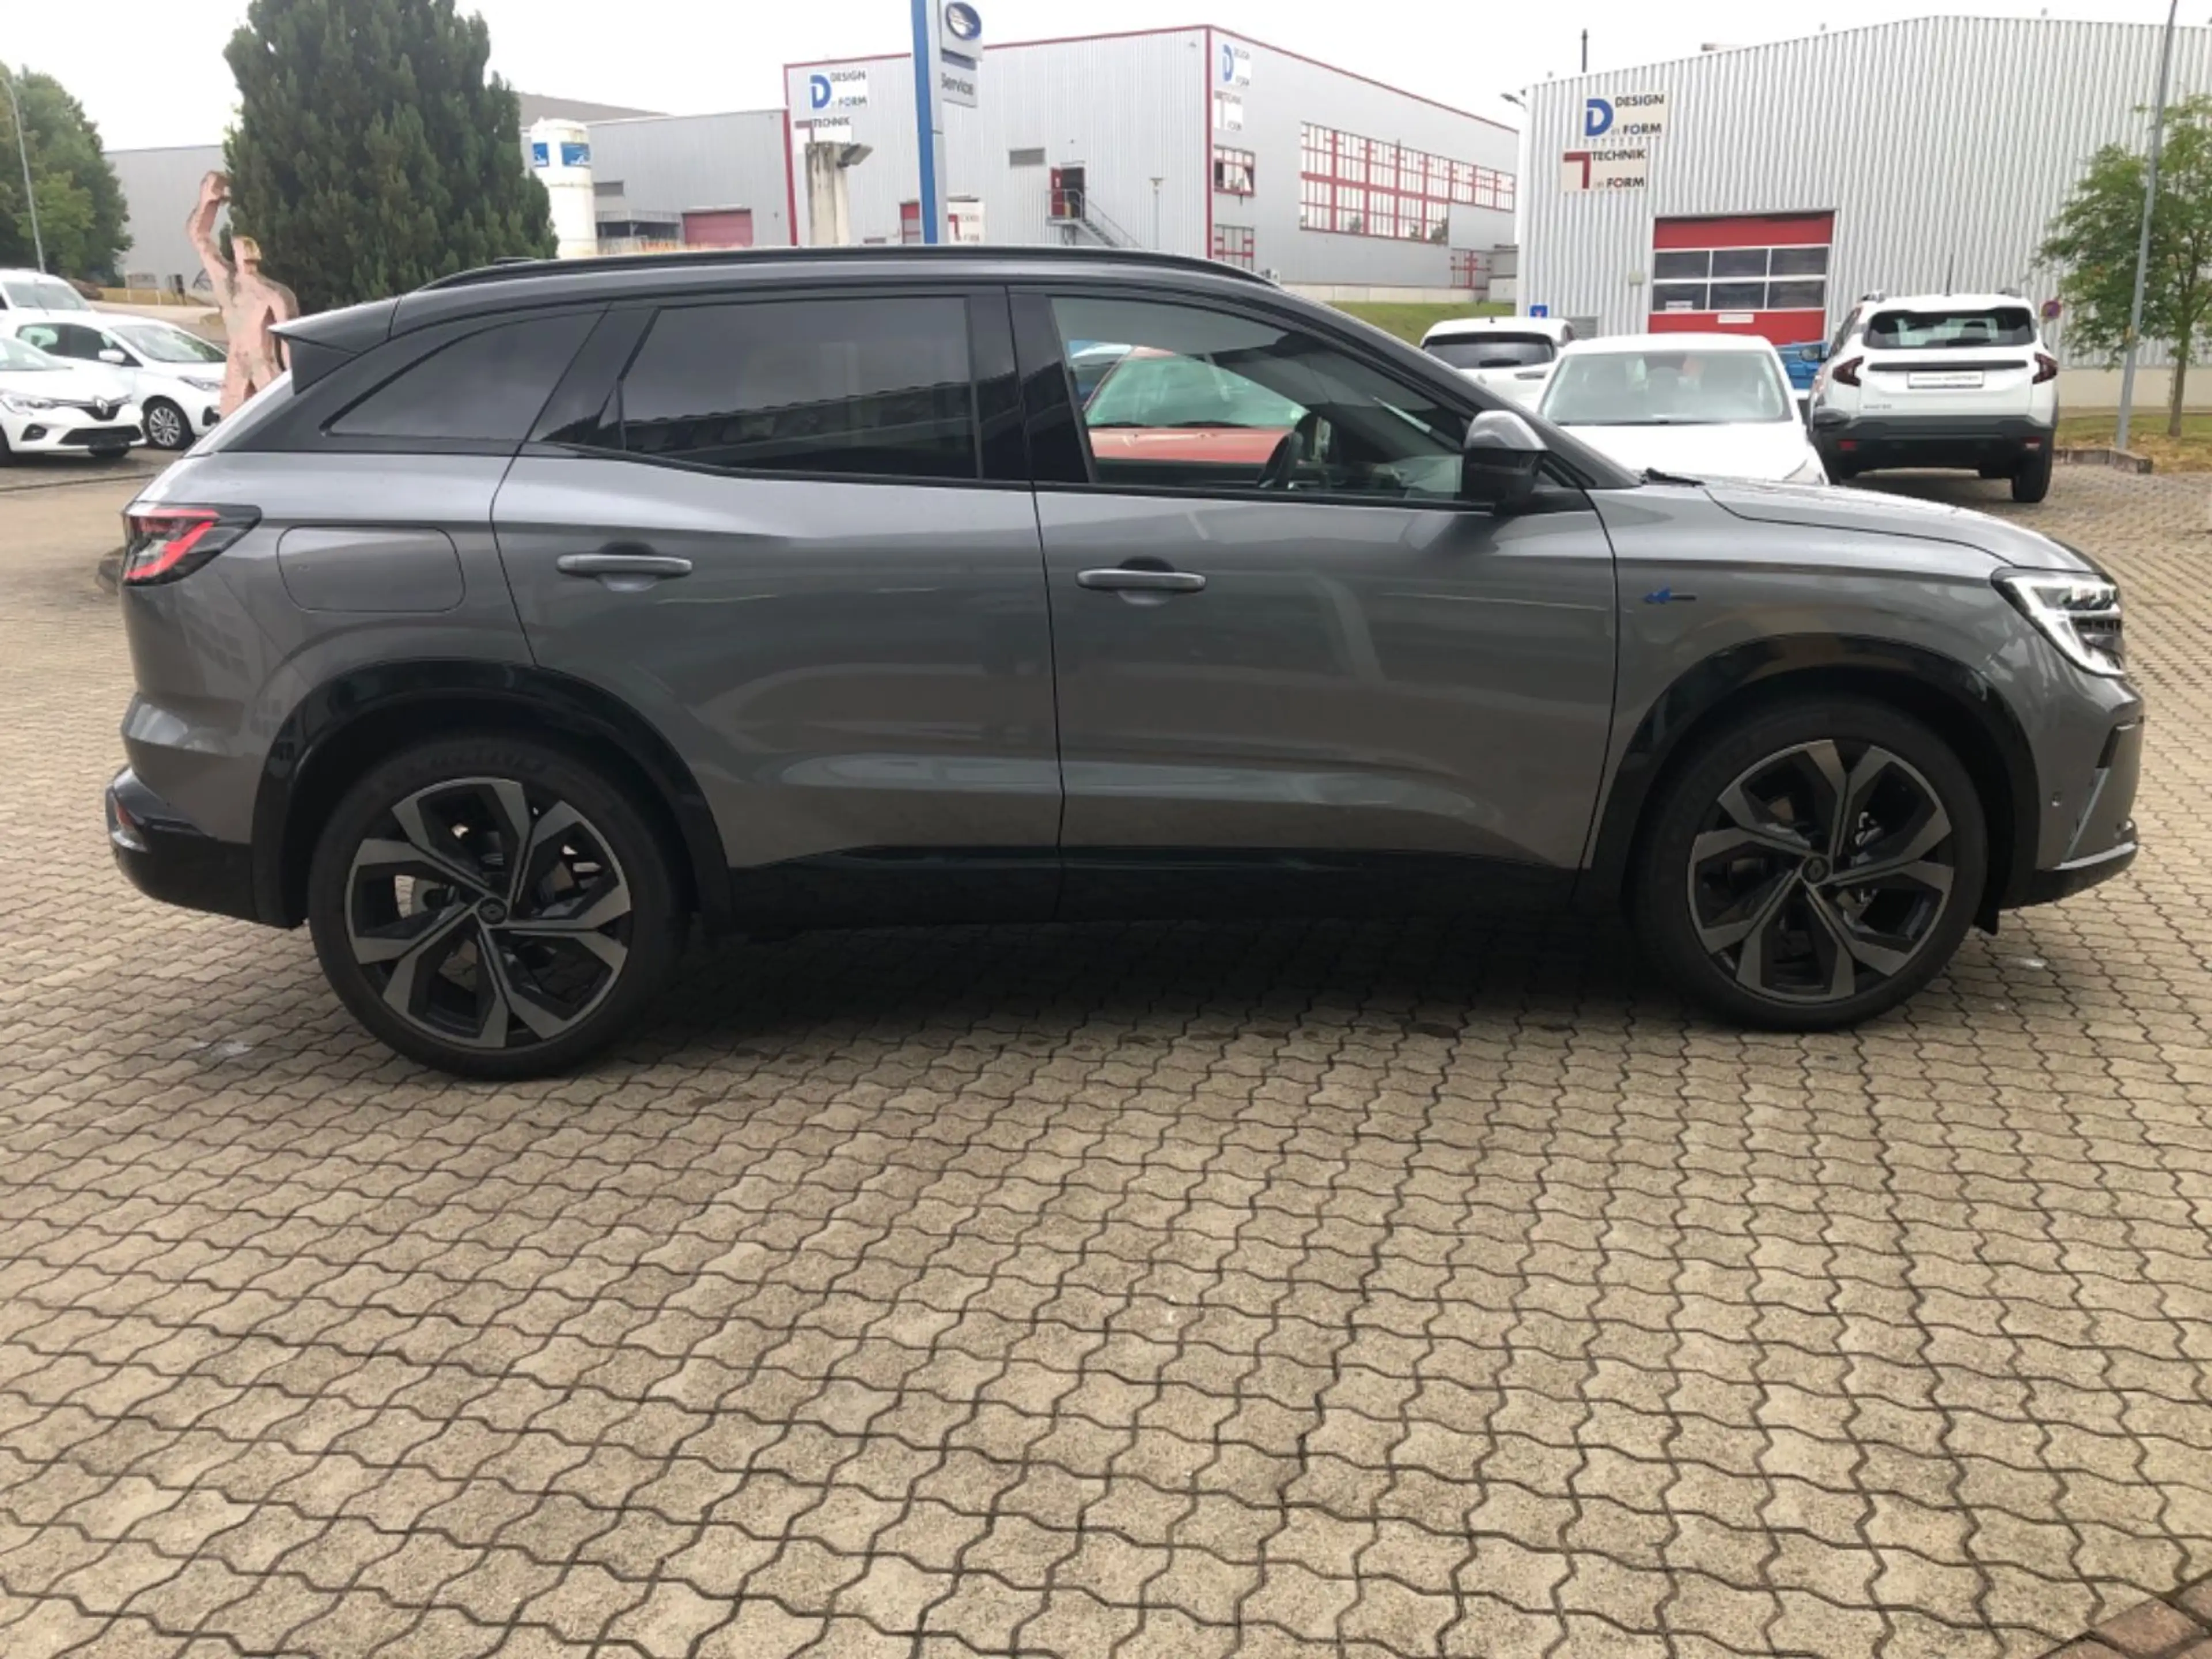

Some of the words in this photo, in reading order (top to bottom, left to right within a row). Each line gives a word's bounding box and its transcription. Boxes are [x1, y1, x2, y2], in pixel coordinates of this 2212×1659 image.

[941, 72, 974, 95] Service
[1615, 94, 1664, 108] DESIGN
[1585, 99, 1613, 136] D
[1623, 123, 1662, 135] FORM
[1593, 149, 1646, 161] TECHNIK
[1606, 177, 1645, 188] FORM
